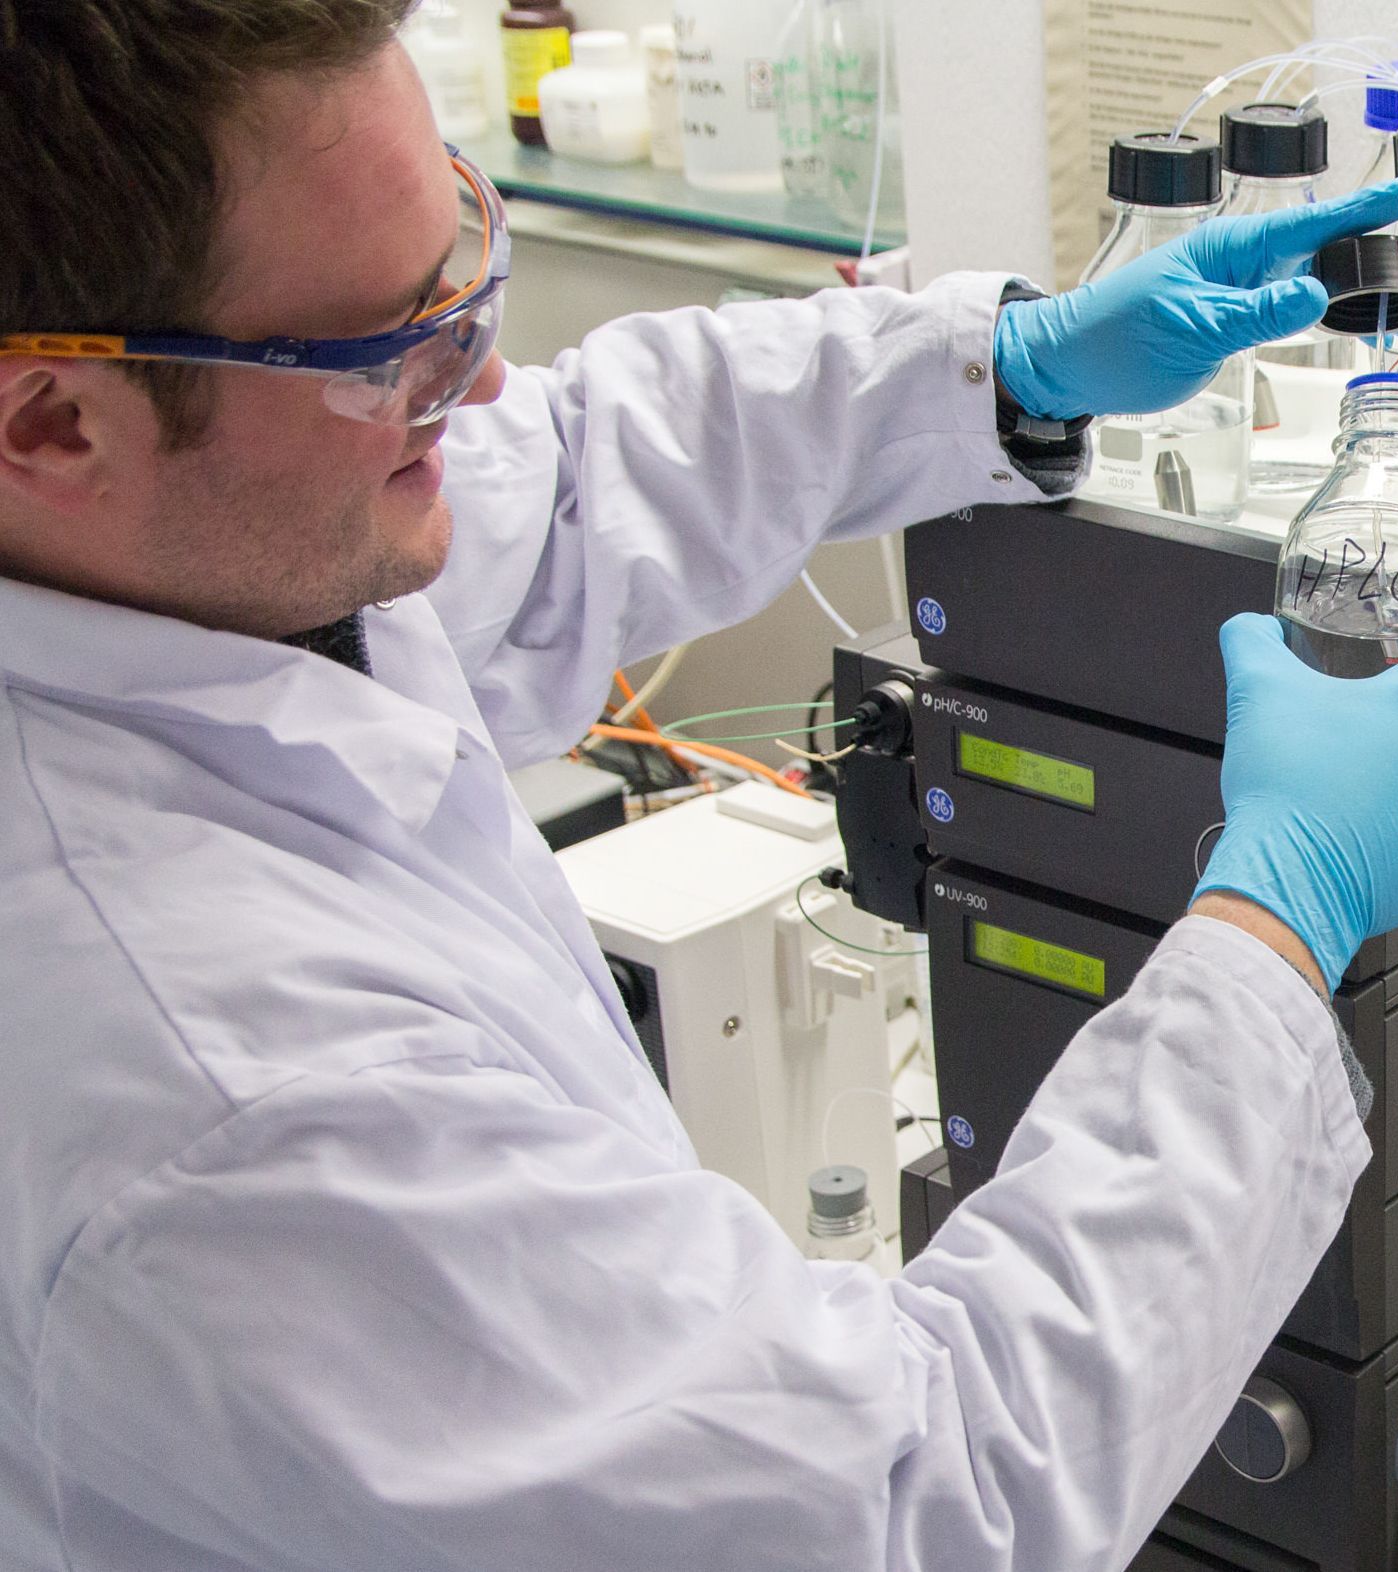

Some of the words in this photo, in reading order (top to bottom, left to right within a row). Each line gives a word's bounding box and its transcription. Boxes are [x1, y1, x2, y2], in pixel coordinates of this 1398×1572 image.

[263, 348, 298, 365] i-vo
[933, 697, 988, 723] pH/C-900
[946, 886, 988, 911] UV-900
